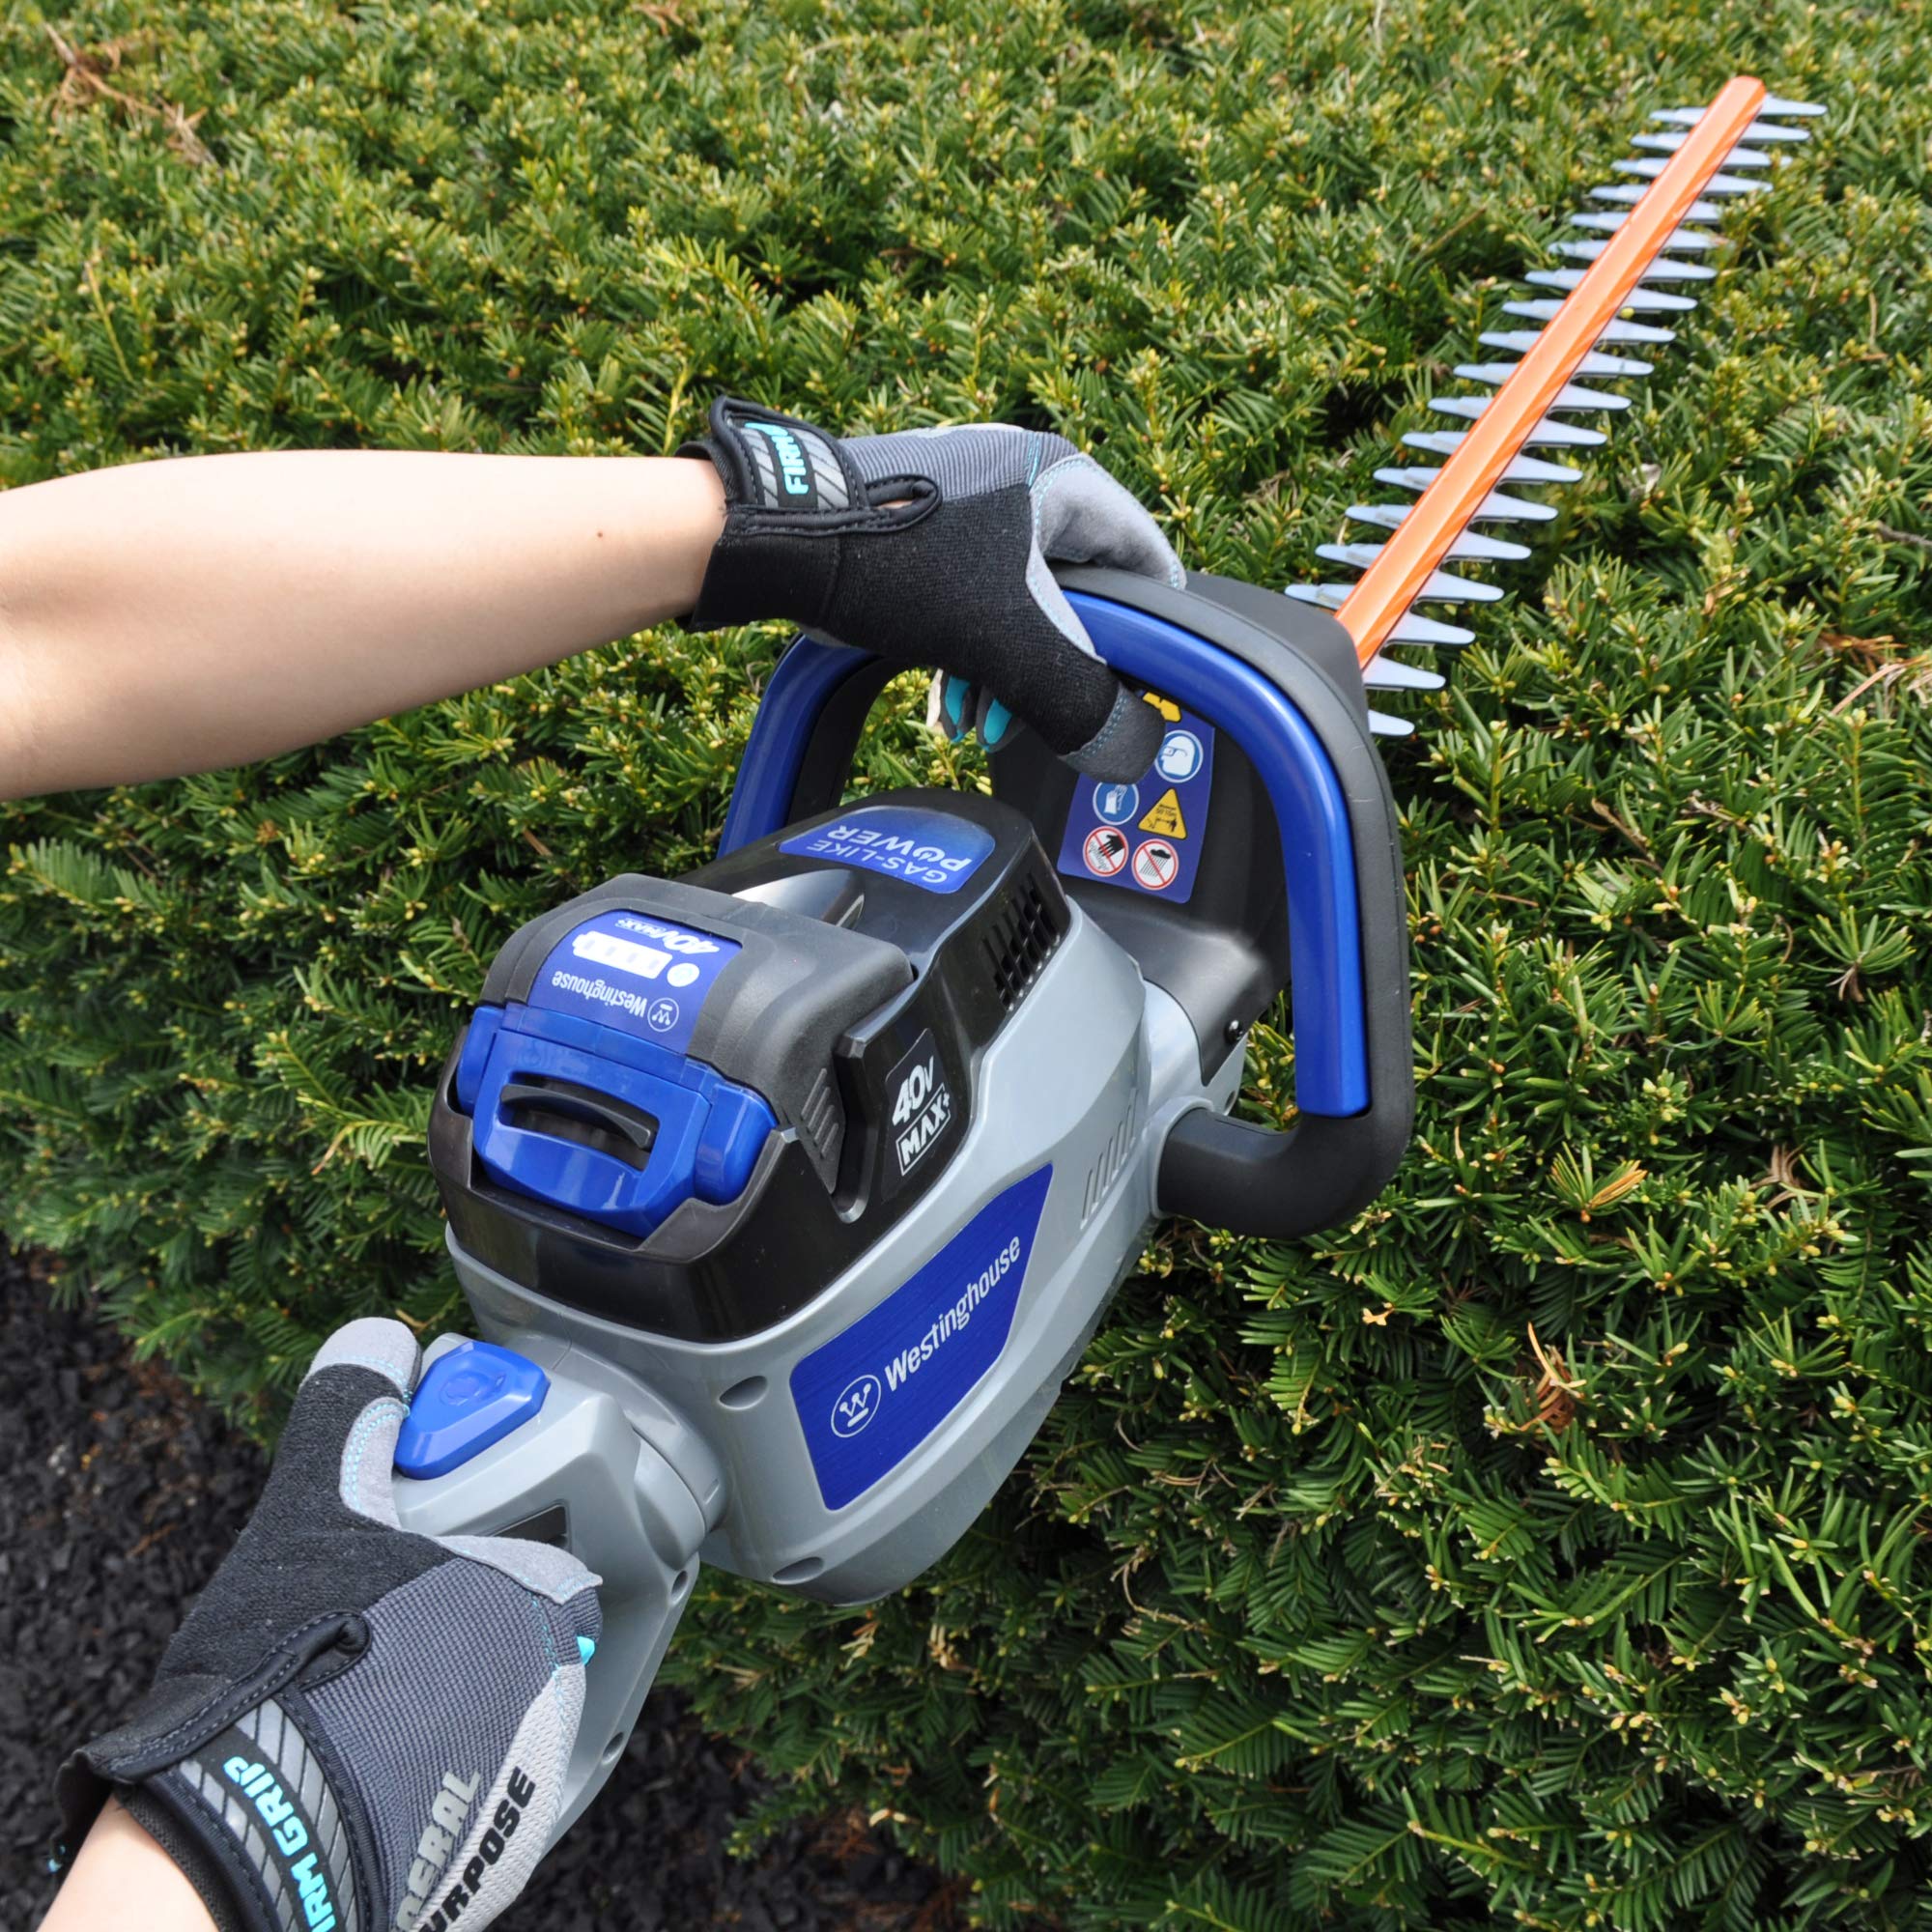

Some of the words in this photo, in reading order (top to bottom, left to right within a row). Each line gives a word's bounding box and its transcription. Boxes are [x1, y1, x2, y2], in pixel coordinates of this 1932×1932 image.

[807, 838, 948, 884] GAS-LIKE
[827, 825, 972, 872] POWER
[552, 970, 648, 1018] Westinghouse
[893, 1055, 934, 1126] 40V
[884, 1236, 1021, 1392] Westinghouse
[223, 1755, 309, 1858] GRIP
